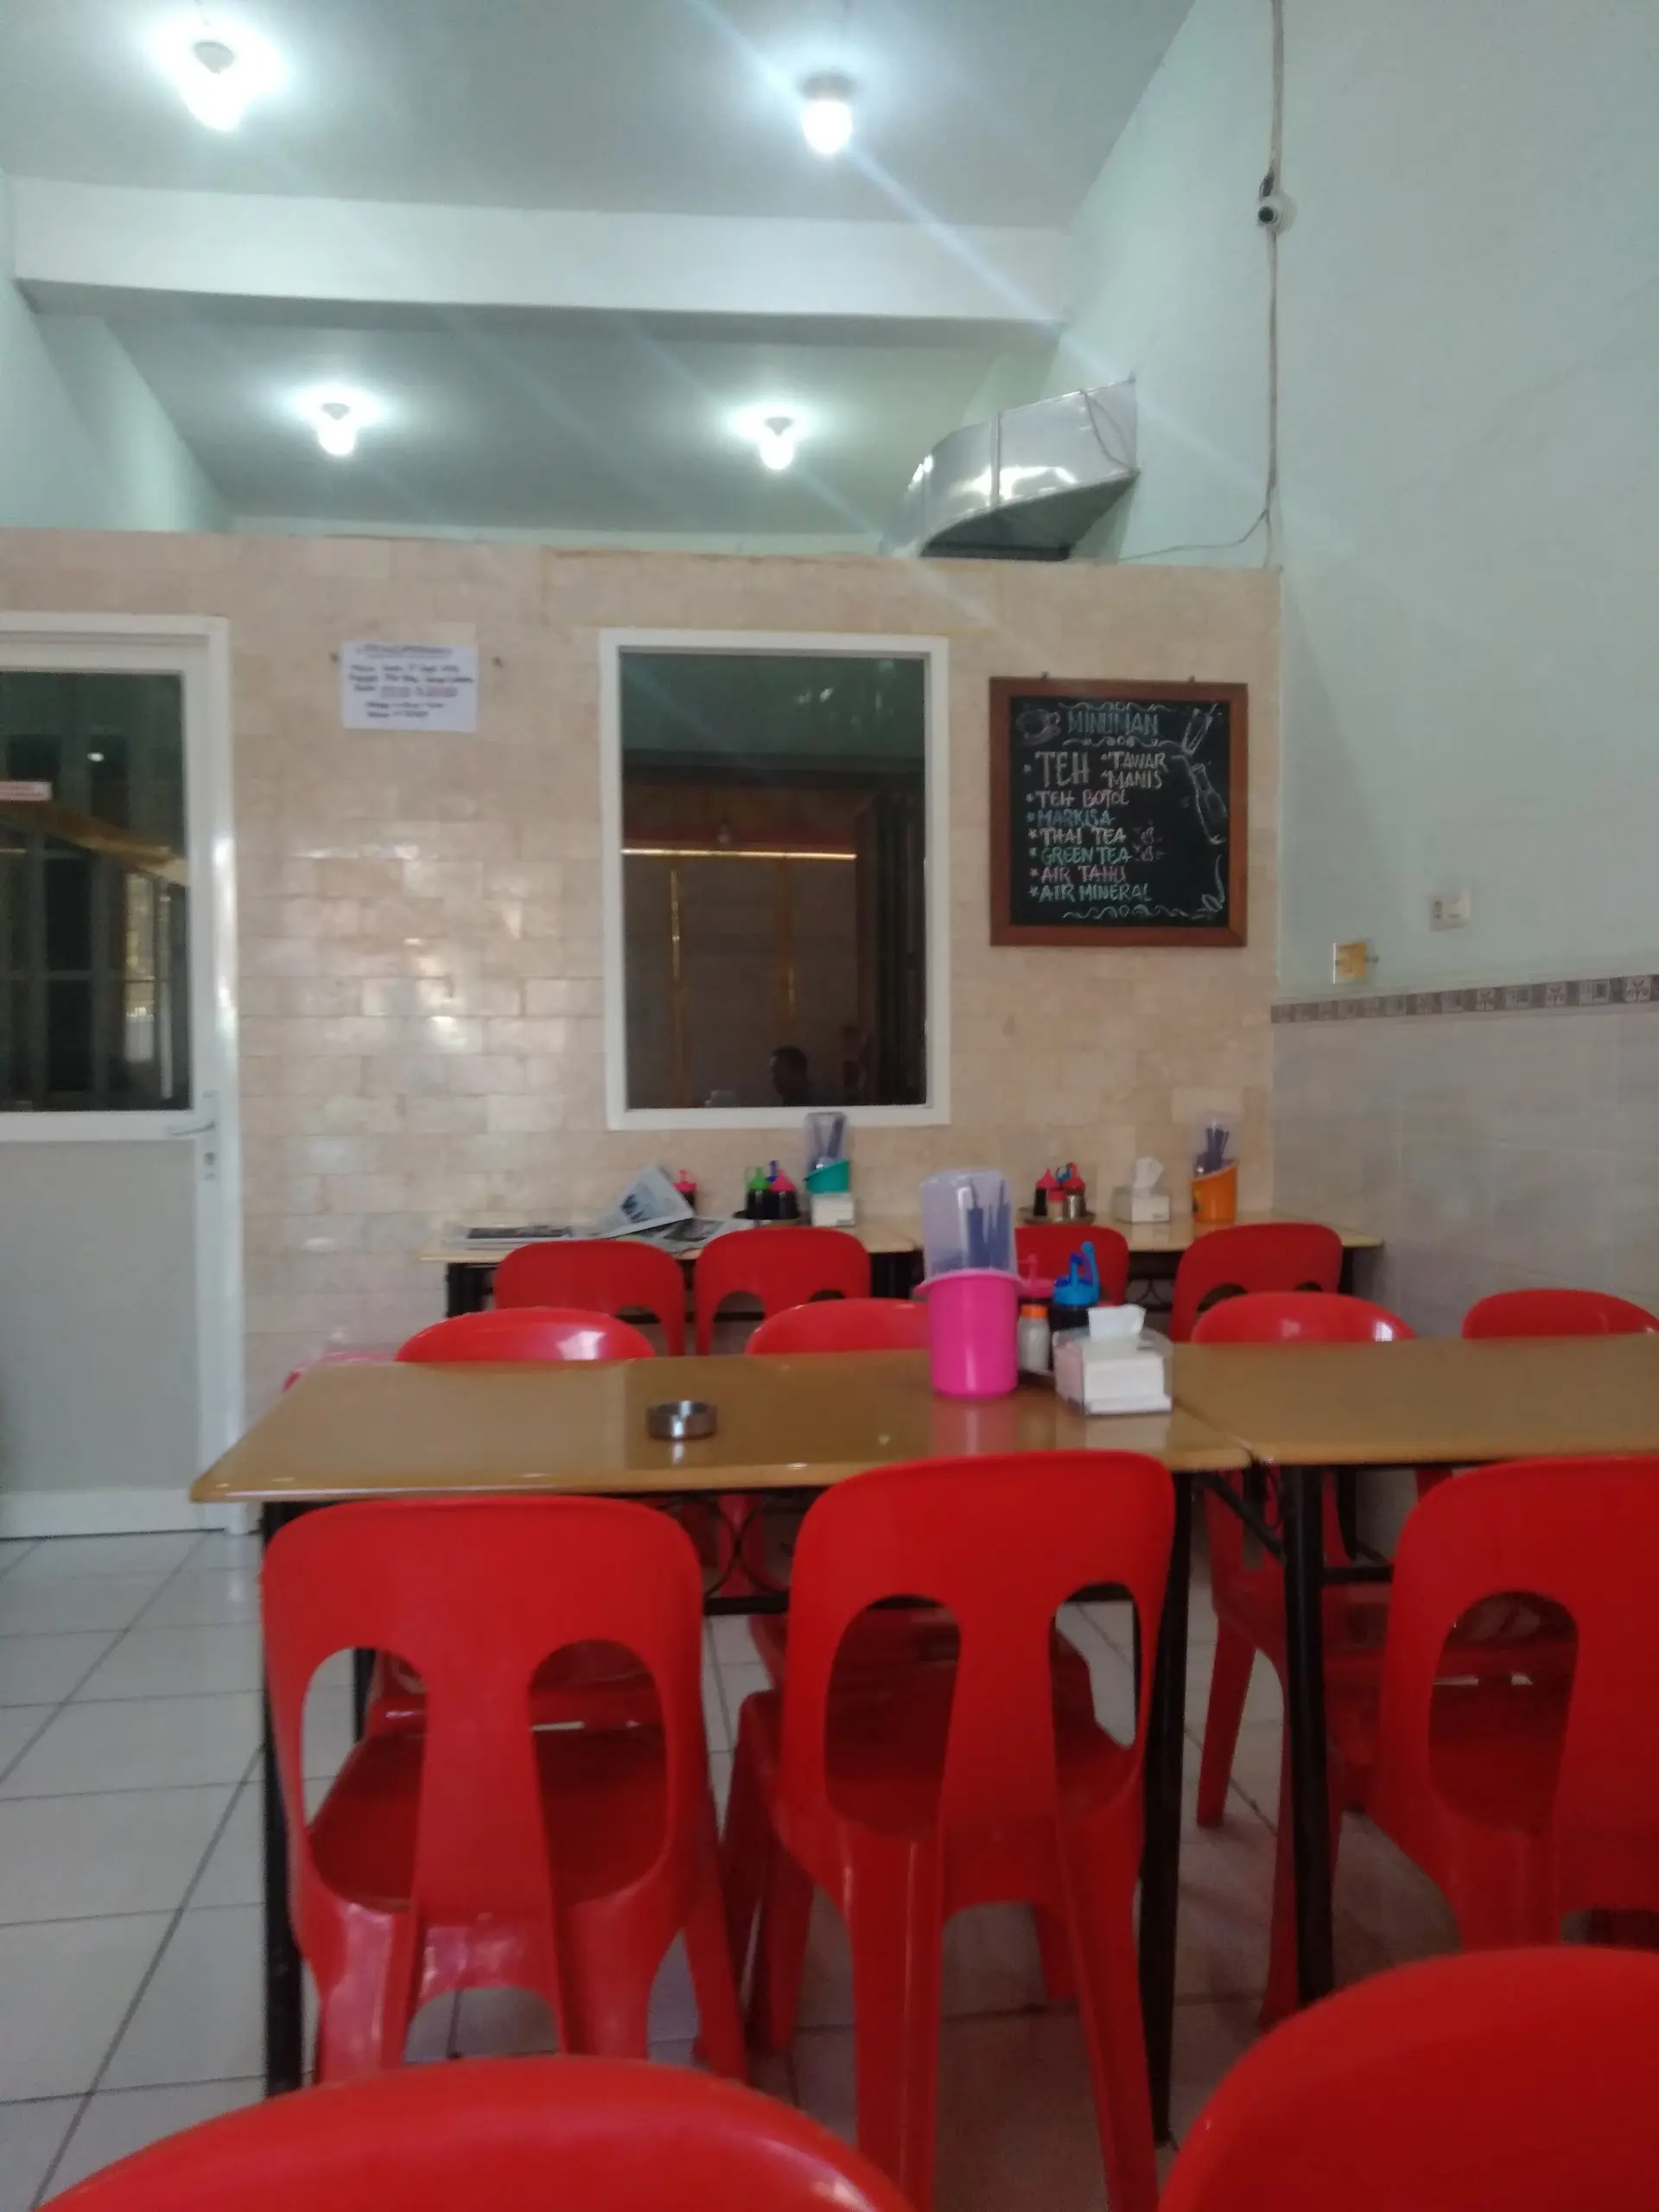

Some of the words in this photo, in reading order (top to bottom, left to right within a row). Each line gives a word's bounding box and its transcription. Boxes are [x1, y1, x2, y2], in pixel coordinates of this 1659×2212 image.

[1067, 711, 1159, 735] MINUMAN
[1035, 751, 1089, 787] TEH
[1035, 790, 1075, 808] TEH
[1083, 788, 1129, 808] BOTOL
[1040, 827, 1082, 846] THAI
[1090, 827, 1126, 845] TEA
[1041, 847, 1094, 865] GREEN
[1096, 847, 1133, 865] TEA
[1041, 866, 1071, 884] AIR
[1077, 865, 1127, 883] TAHU
[1039, 883, 1076, 903] AIR
[1078, 883, 1153, 902] MINERAL
